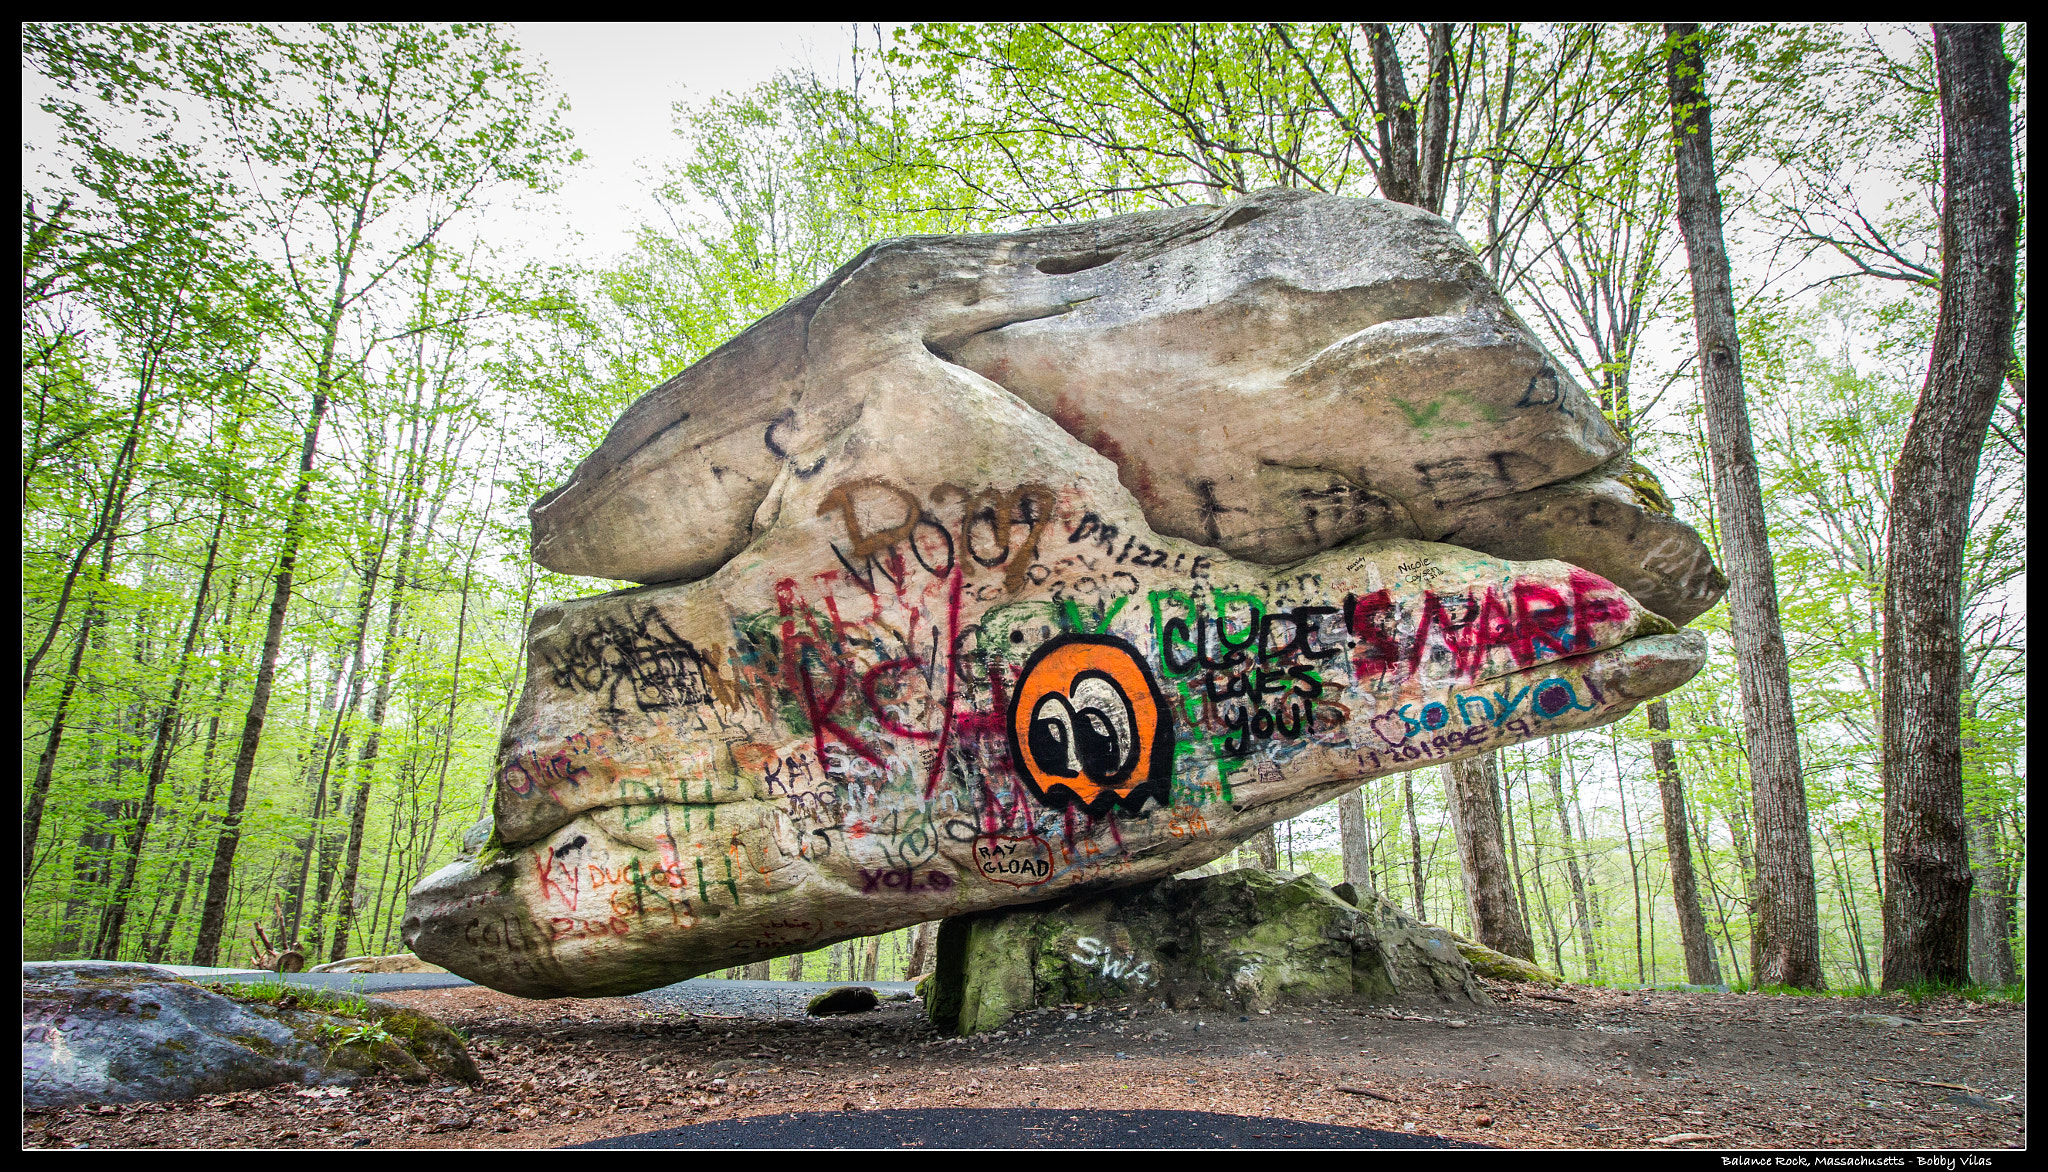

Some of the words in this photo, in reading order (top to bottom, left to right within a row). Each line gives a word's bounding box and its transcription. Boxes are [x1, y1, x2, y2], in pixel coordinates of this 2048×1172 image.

[1398, 557, 1431, 574] Nicole
[978, 843, 1017, 860] RAY
[983, 859, 1050, 877] GLOAD
